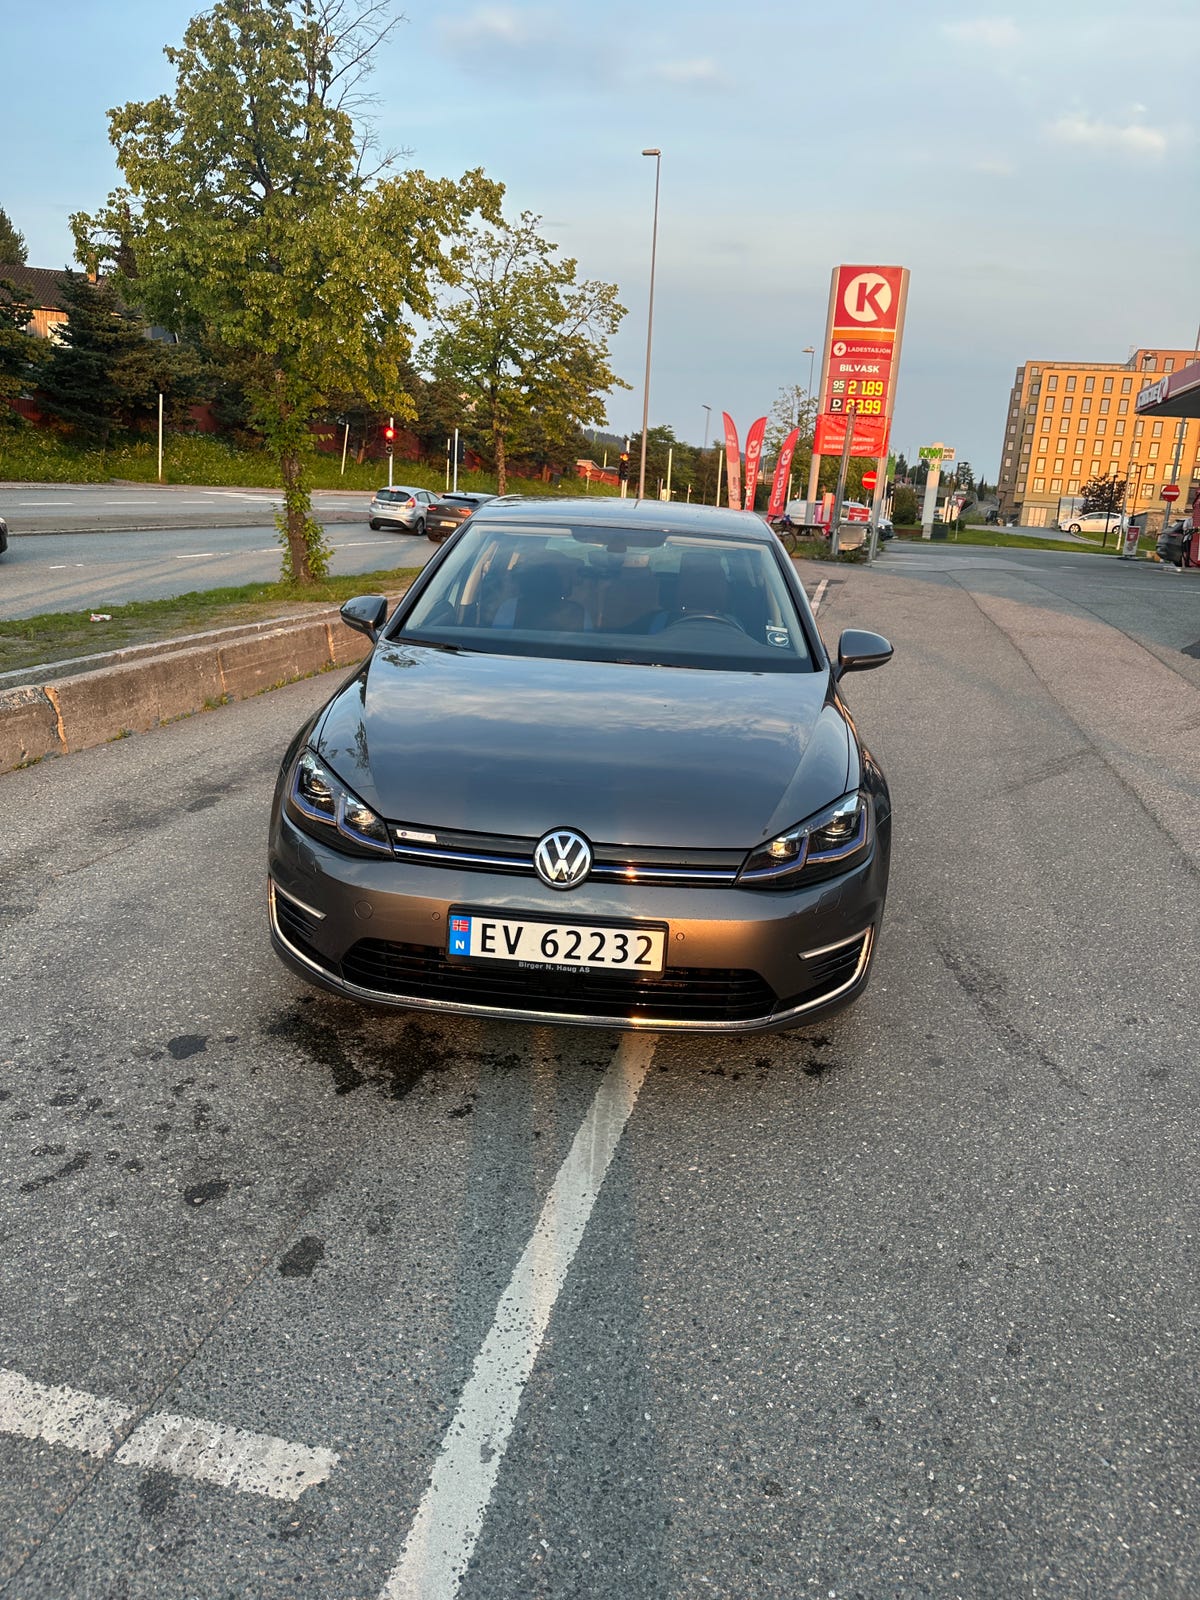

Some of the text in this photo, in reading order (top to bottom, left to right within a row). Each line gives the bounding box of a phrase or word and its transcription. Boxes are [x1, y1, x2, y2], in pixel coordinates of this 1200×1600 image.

[854, 281, 888, 321] K
[847, 345, 891, 354] LADESTASJON
[839, 364, 880, 373] BILVASK
[833, 380, 845, 389] 95
[832, 399, 842, 408] D
[919, 447, 944, 459] KIWI
[773, 467, 786, 507] CIRCLE
[455, 940, 465, 950] N
[480, 923, 653, 965] EV 62232
[518, 961, 543, 970] Birger
[556, 965, 577, 973] Haug
